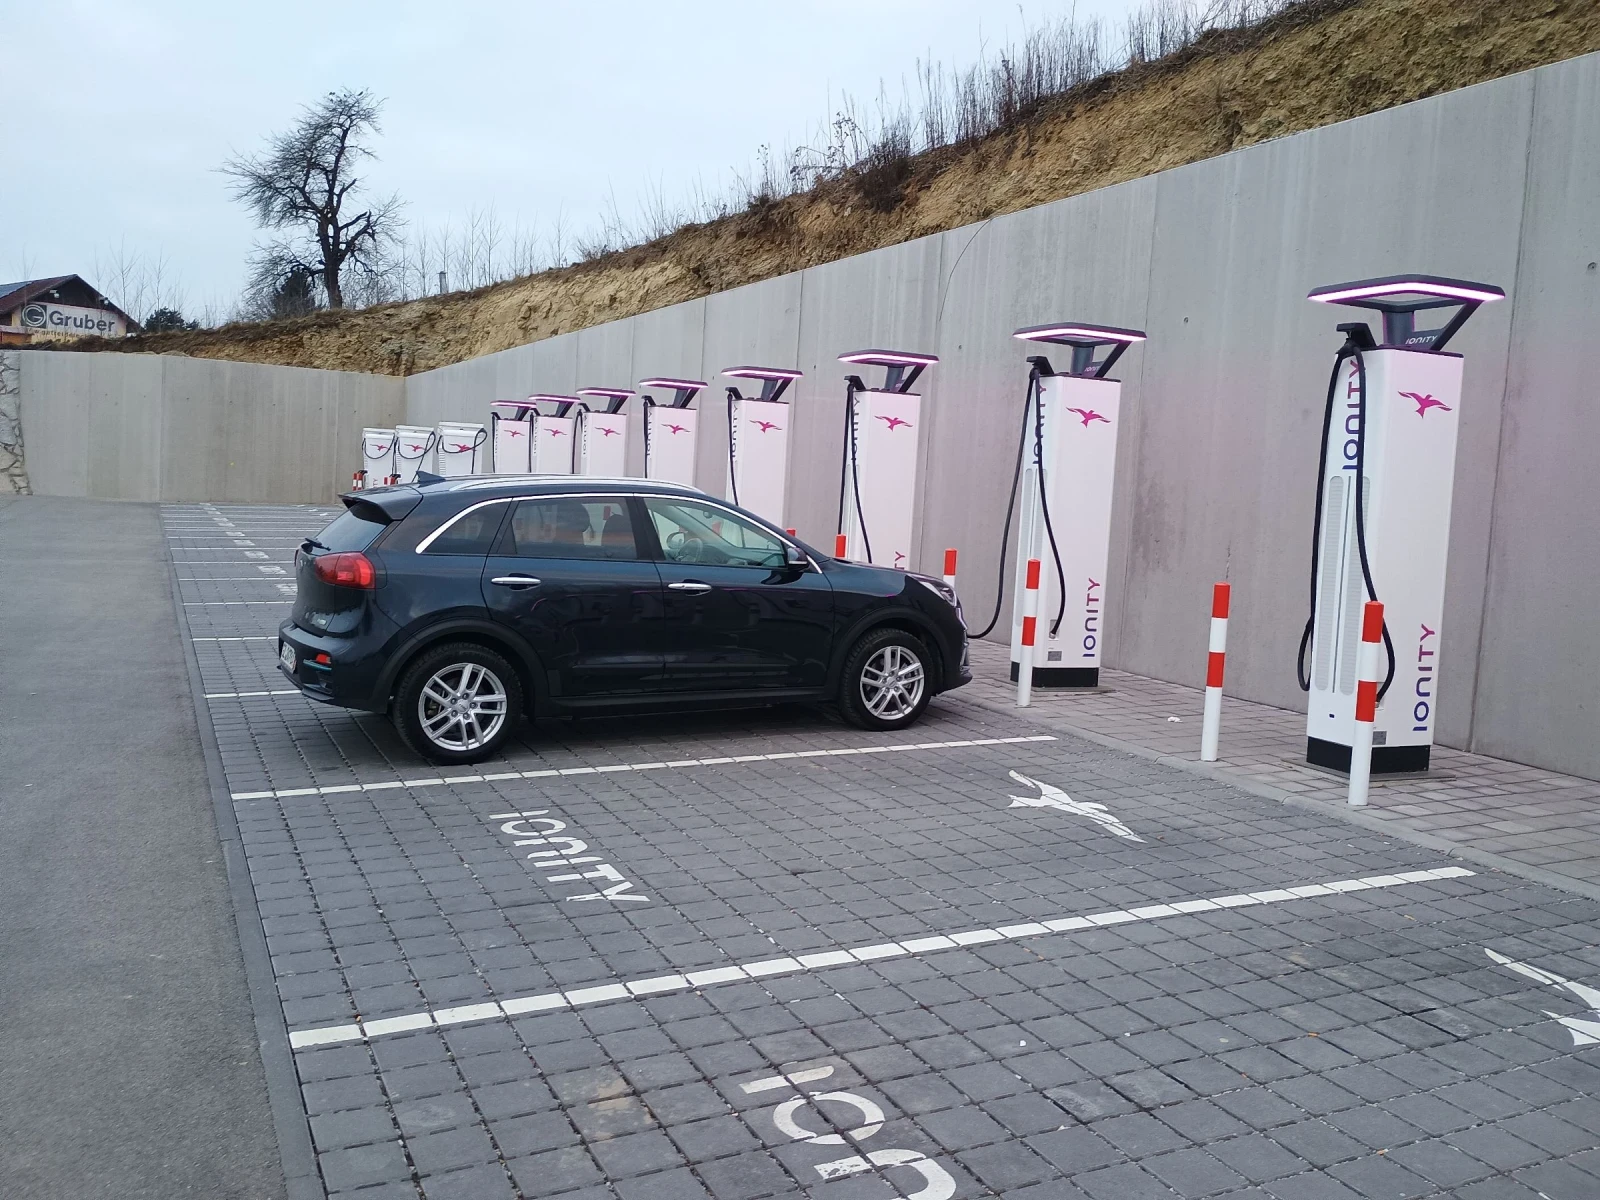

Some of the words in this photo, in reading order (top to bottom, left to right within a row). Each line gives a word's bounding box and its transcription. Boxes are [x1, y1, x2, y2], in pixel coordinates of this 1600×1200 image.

[50, 310, 115, 332] Gruber
[1405, 335, 1438, 345] IONITY
[1082, 577, 1101, 658] IONITY
[1412, 623, 1436, 732] IONITY
[488, 809, 651, 902] IONITY
